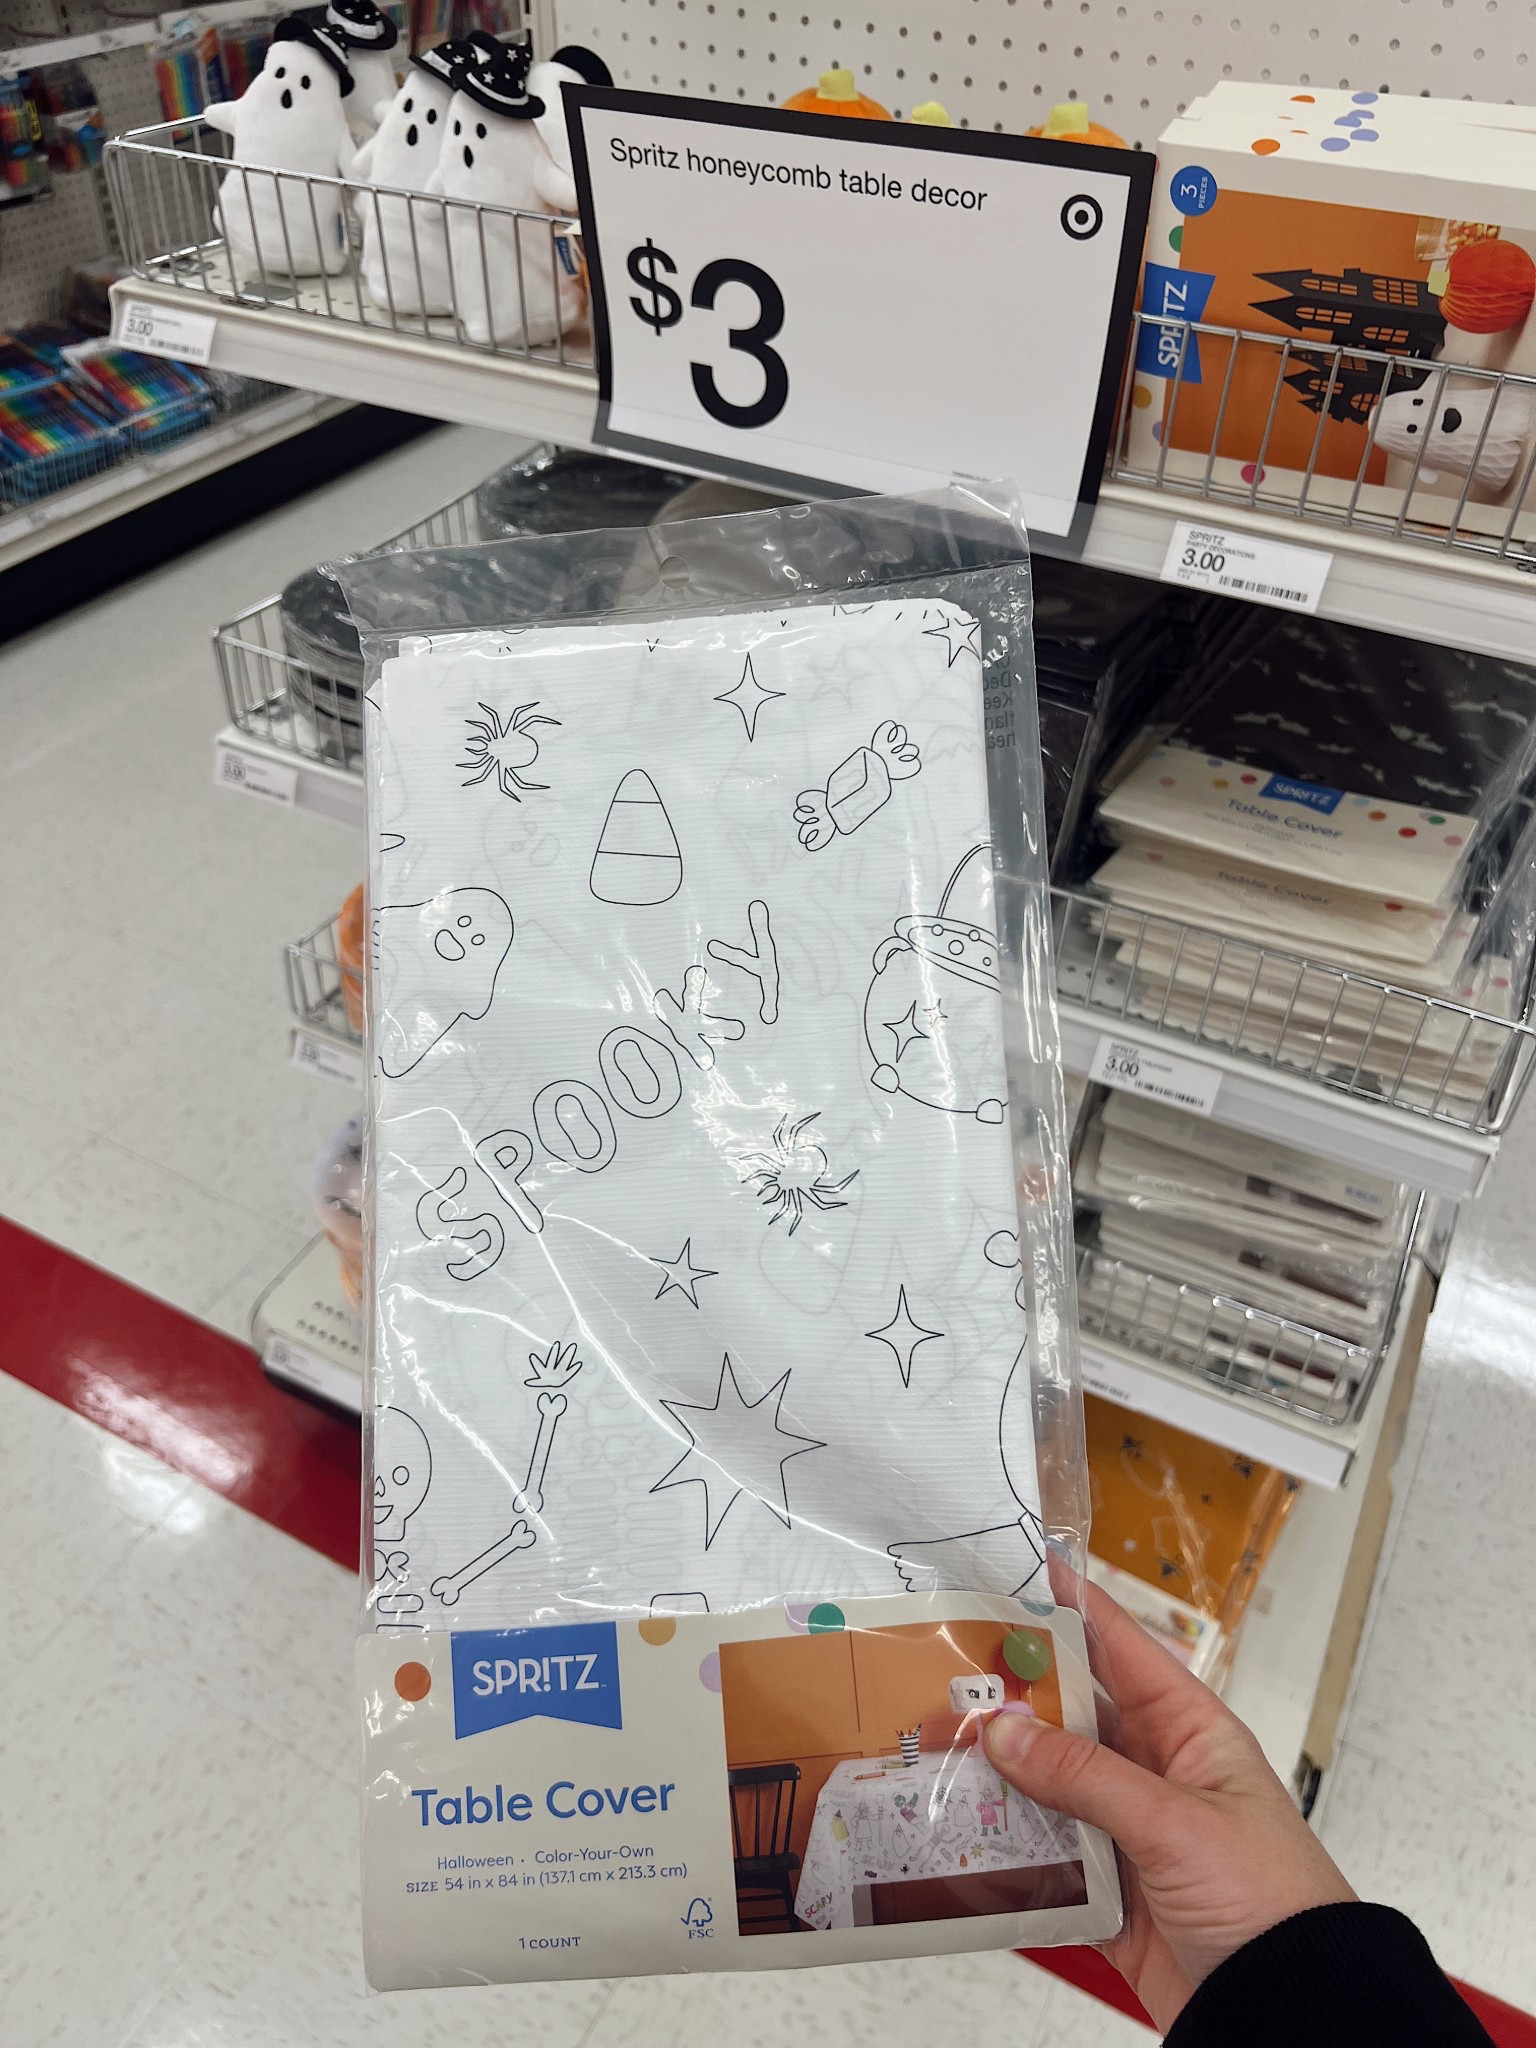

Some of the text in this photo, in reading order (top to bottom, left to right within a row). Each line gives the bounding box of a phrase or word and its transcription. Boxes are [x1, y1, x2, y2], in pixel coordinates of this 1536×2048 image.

[610, 137, 988, 211] Spritz honeycomb table decor
[1180, 183, 1198, 199] 3
[1197, 175, 1209, 210] PIECES
[626, 237, 790, 430] $3
[1188, 530, 1226, 547] SPRITZ
[1182, 548, 1225, 572] 3.00
[1228, 799, 1279, 822] Table
[1284, 815, 1343, 839] Cover
[1105, 1055, 1139, 1077] 3.00
[416, 900, 779, 1281] SPOOKY
[412, 1781, 675, 1826] Table Cover
[437, 1845, 654, 1870] Halloween Color-Your-Own
[406, 1862, 687, 1893] SIZE 54 in x 84 in (137.1 cm x 213.3 cm)
[804, 1891, 833, 1919] SCARY
[518, 1936, 581, 1950] 1 COUNT
[688, 1928, 715, 1939] FSC
